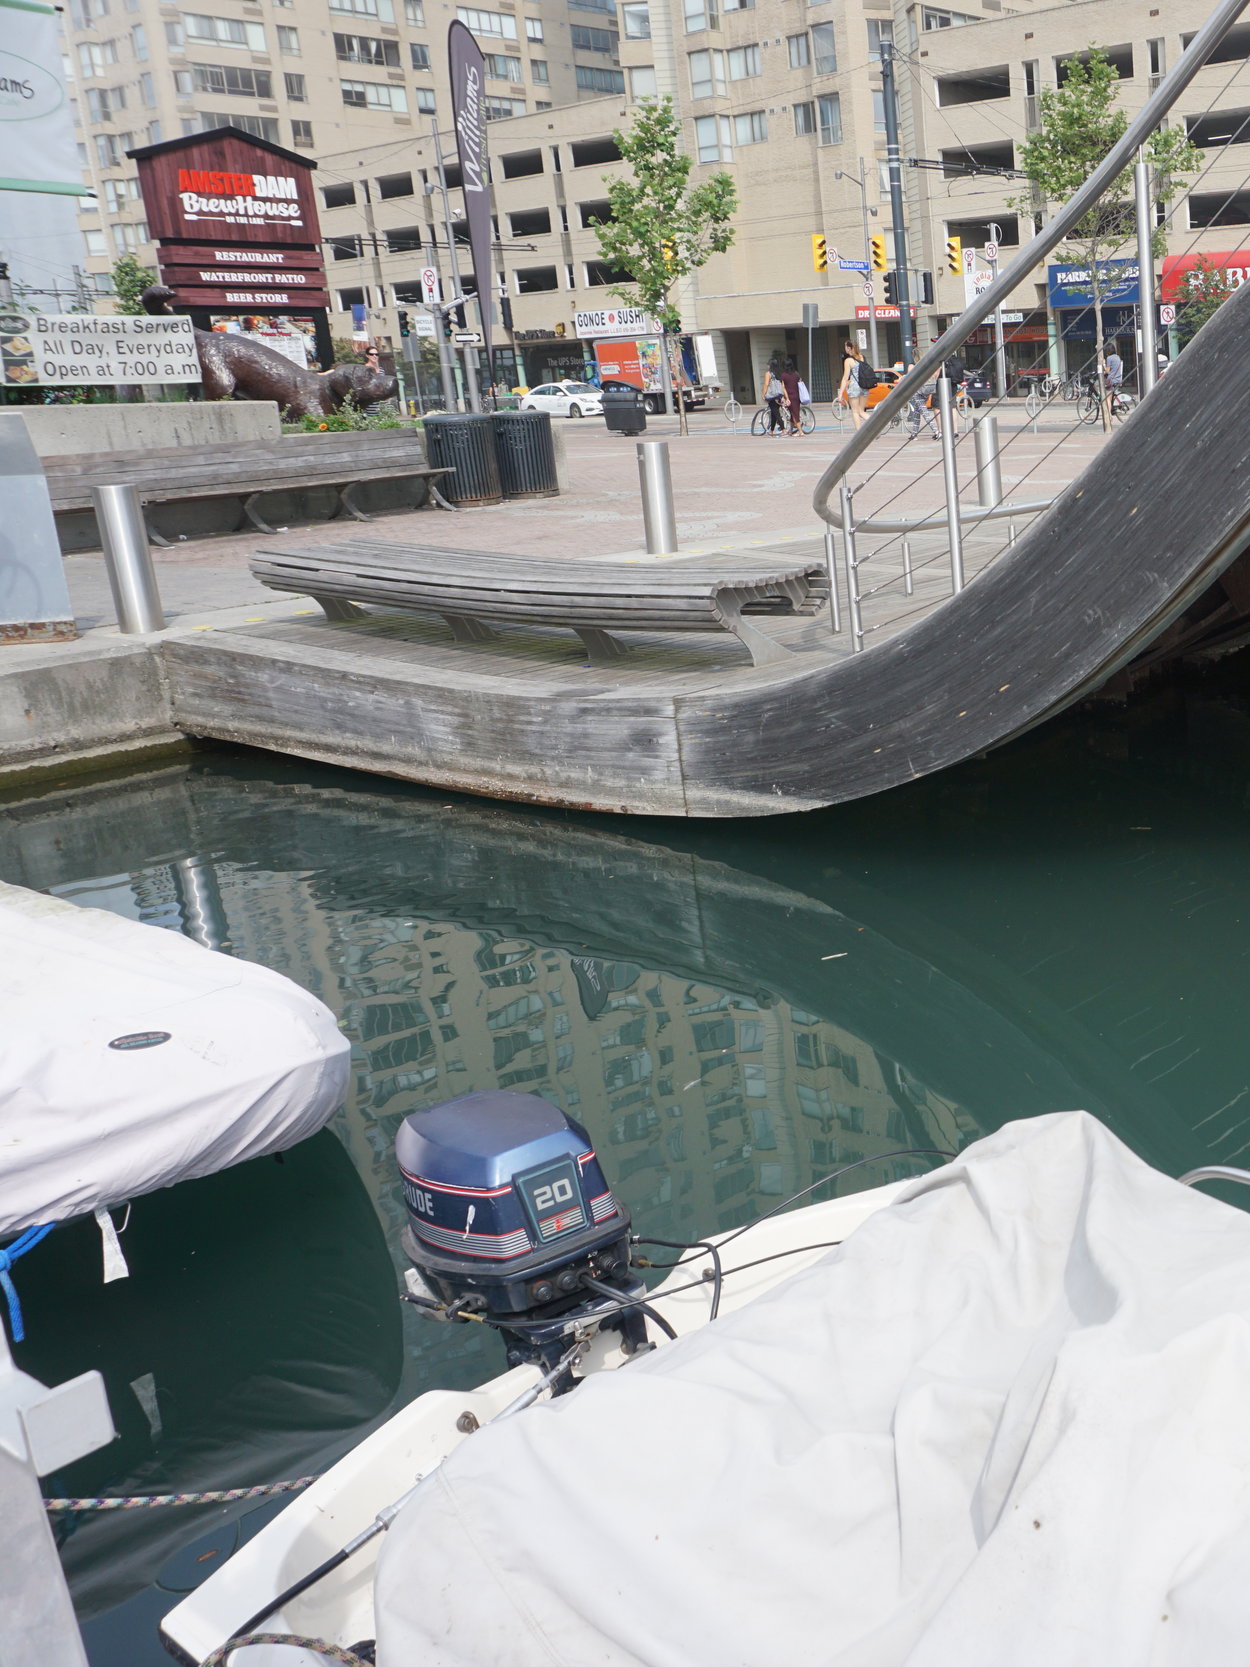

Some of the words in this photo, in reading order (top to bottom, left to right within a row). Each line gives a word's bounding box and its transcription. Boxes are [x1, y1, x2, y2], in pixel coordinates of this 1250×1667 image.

[457, 62, 484, 193] Williams
[179, 168, 298, 199] AMSTERDAM
[178, 192, 301, 217] BrewHouse
[214, 251, 284, 263] RESTAURANT
[199, 271, 273, 283] WATERFRONT
[274, 273, 306, 284] PATIO
[225, 292, 254, 302] BEER
[254, 294, 289, 303] STORE
[37, 318, 127, 334] Breakfast
[133, 319, 192, 334] Served
[577, 312, 606, 327] GONOE
[43, 340, 66, 355] All
[71, 340, 110, 358] Day,
[116, 340, 194, 358] Everyday
[44, 361, 91, 379] Open
[96, 363, 114, 377] at
[118, 361, 157, 376] 7:00
[547, 357, 558, 367] The
[533, 1178, 574, 1211] 20
